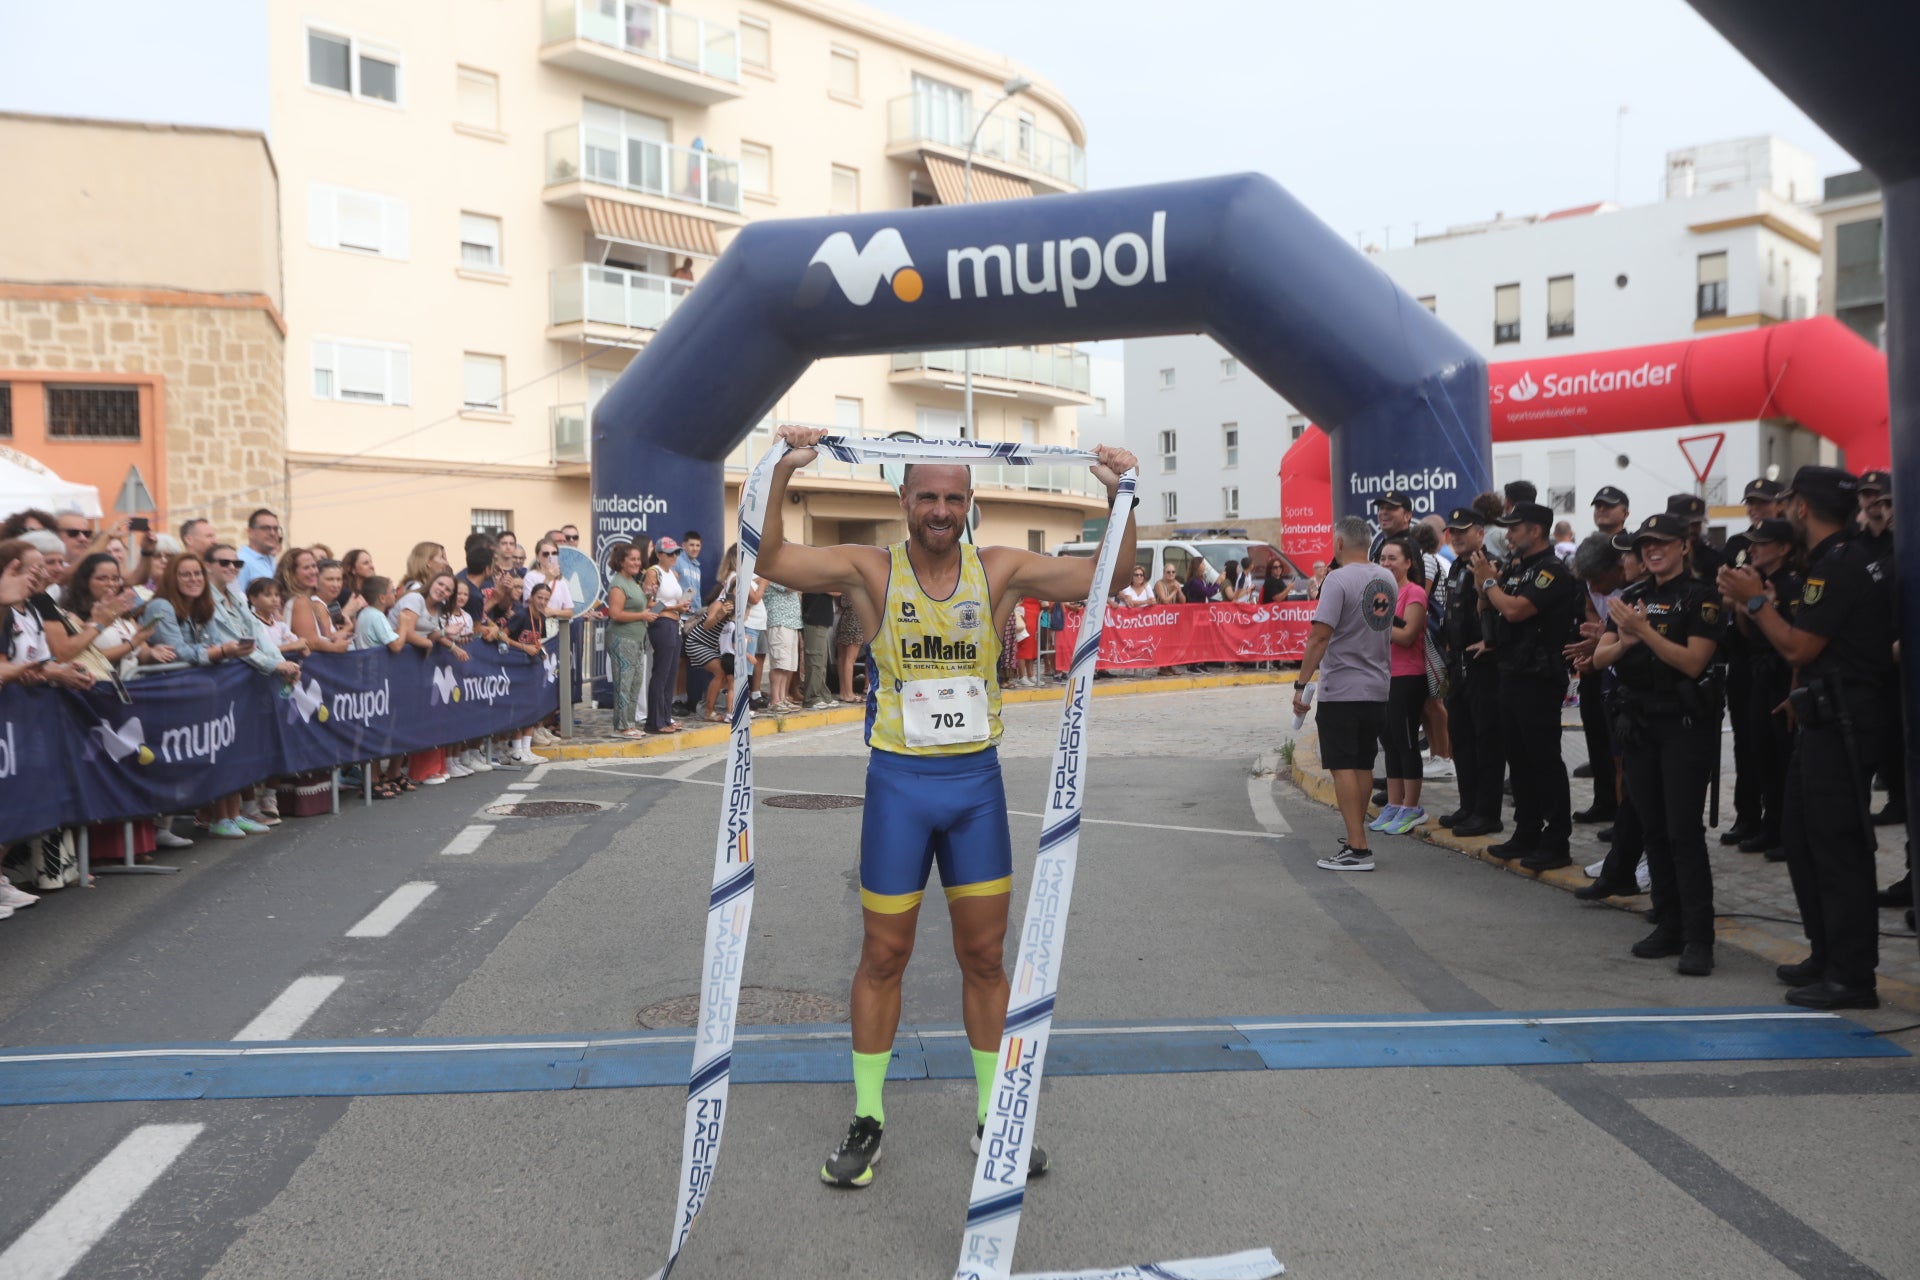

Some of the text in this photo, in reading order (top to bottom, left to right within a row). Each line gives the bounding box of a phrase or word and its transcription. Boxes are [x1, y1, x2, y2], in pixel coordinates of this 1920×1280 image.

[947, 210, 1167, 308] mupol
[1541, 361, 1678, 399] Santander
[1350, 467, 1457, 494] fundación
[592, 493, 668, 513] fundación
[1285, 505, 1314, 519] Sports
[599, 513, 647, 535] mupol
[1284, 522, 1332, 535] Santander
[1116, 609, 1180, 629] Santander
[1209, 606, 1251, 626] Sports
[333, 678, 390, 727] mupol
[464, 666, 512, 706] mupol
[161, 701, 235, 764] mupol
[931, 712, 965, 729] 702
[1065, 675, 1086, 810] NACIONAL
[727, 729, 744, 863] NACIONAL
[1001, 1041, 1038, 1185] NACIONAL
[678, 1099, 709, 1250] NACIONAL
